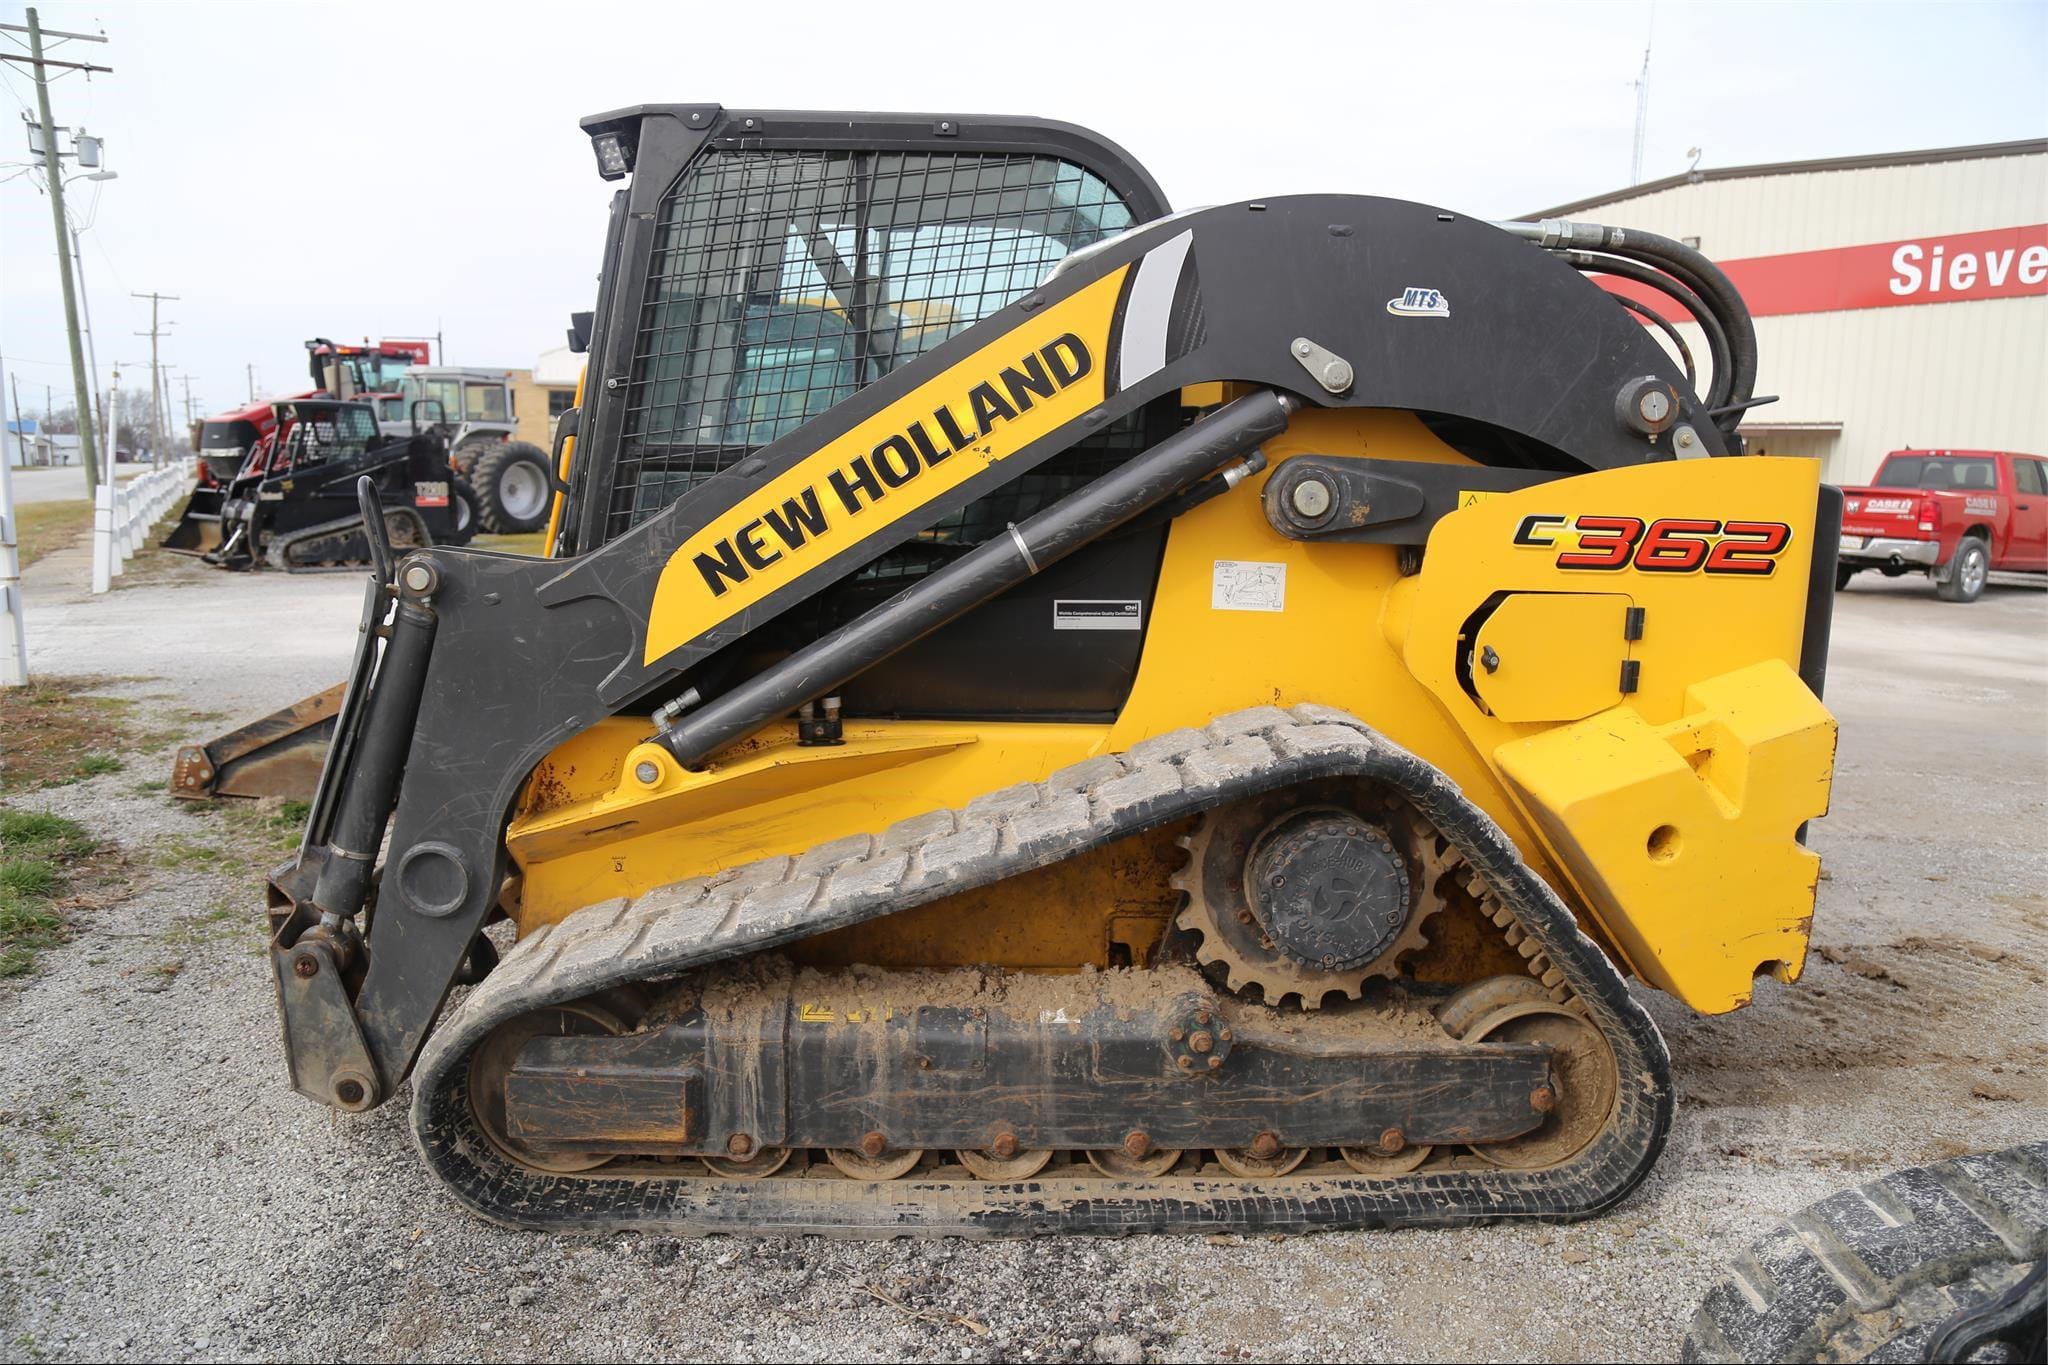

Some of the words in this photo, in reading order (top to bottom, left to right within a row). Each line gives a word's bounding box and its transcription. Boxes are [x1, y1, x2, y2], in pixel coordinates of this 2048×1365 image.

[1889, 244, 2048, 295] Sieve
[1403, 289, 1439, 309] MTS
[692, 484, 829, 597] NEW
[827, 332, 1093, 516] HOLLAND
